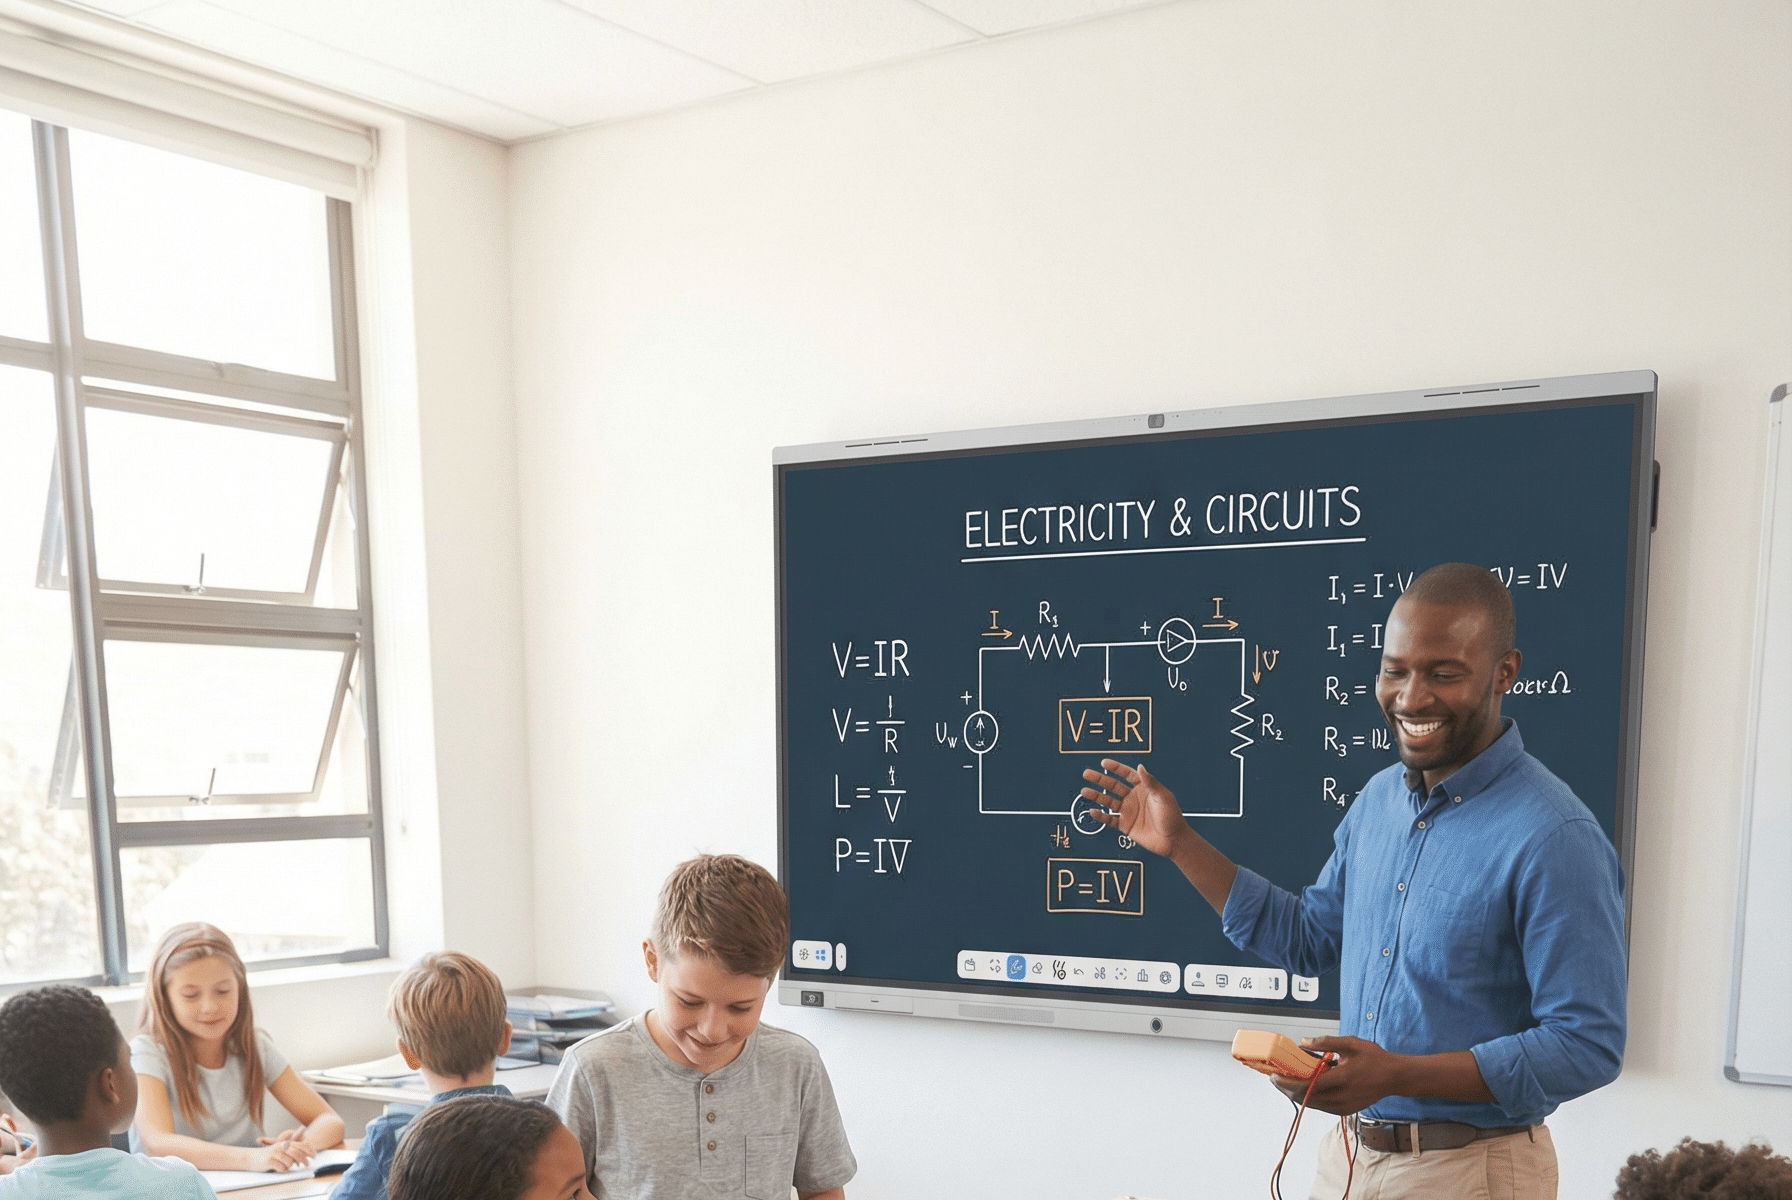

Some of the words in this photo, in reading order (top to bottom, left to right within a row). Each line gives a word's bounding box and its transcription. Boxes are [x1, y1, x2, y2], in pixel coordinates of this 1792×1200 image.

[965, 499, 1156, 548] ELECTRICITY
[1169, 497, 1191, 536] &
[1206, 485, 1361, 535] CIRCUITS
[832, 639, 910, 679] V=IR
[1066, 708, 1144, 743] V=IR
[836, 837, 913, 874] P=IV
[1058, 869, 1134, 904] P=IV
